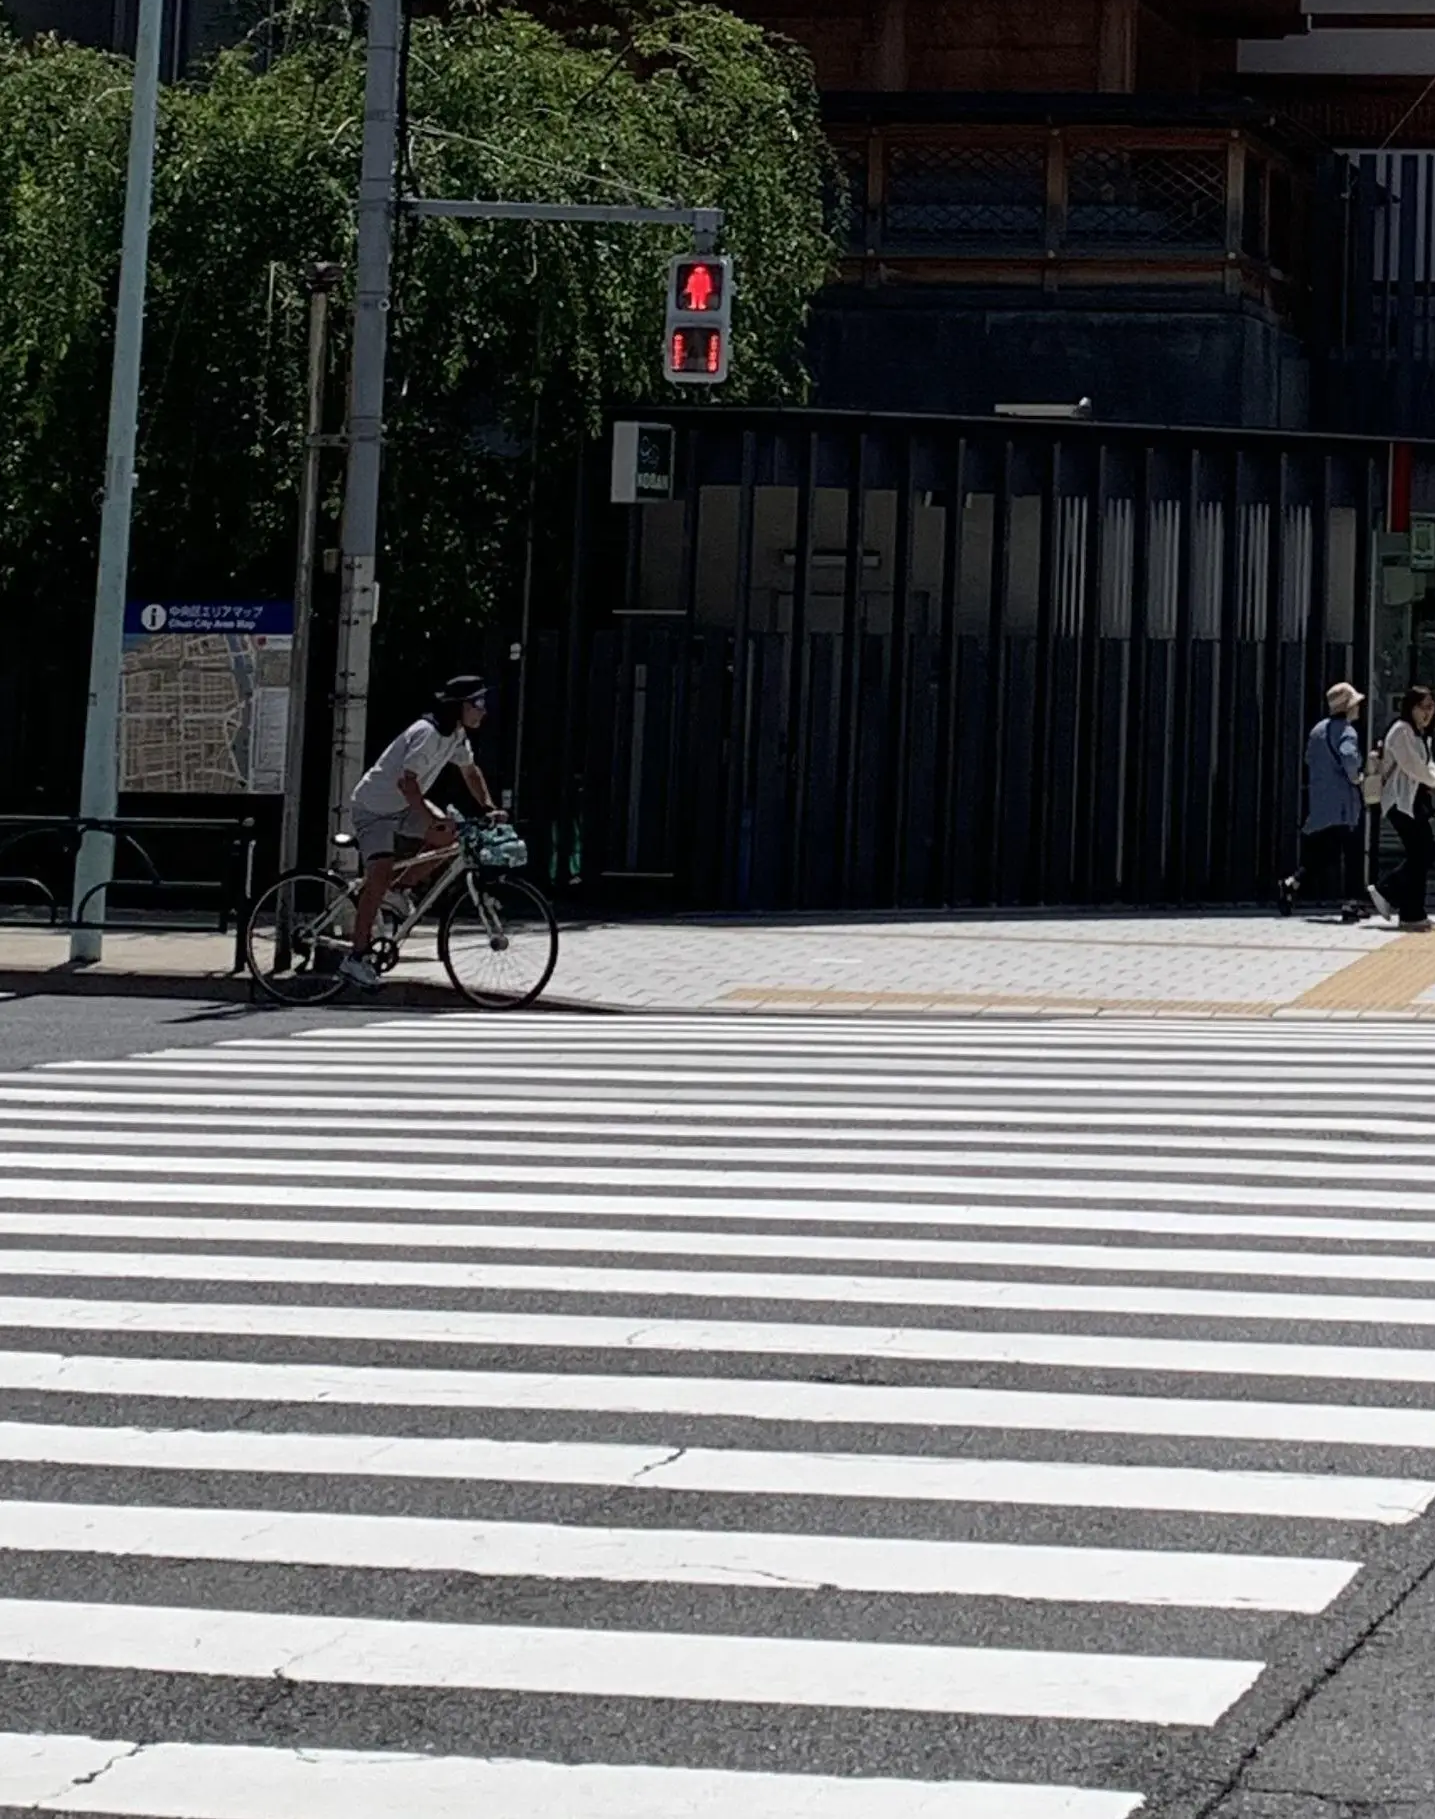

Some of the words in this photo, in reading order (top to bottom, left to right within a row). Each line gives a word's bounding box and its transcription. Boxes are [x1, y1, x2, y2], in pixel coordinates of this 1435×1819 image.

[169, 604, 264, 618] 中央区エリアマップ
